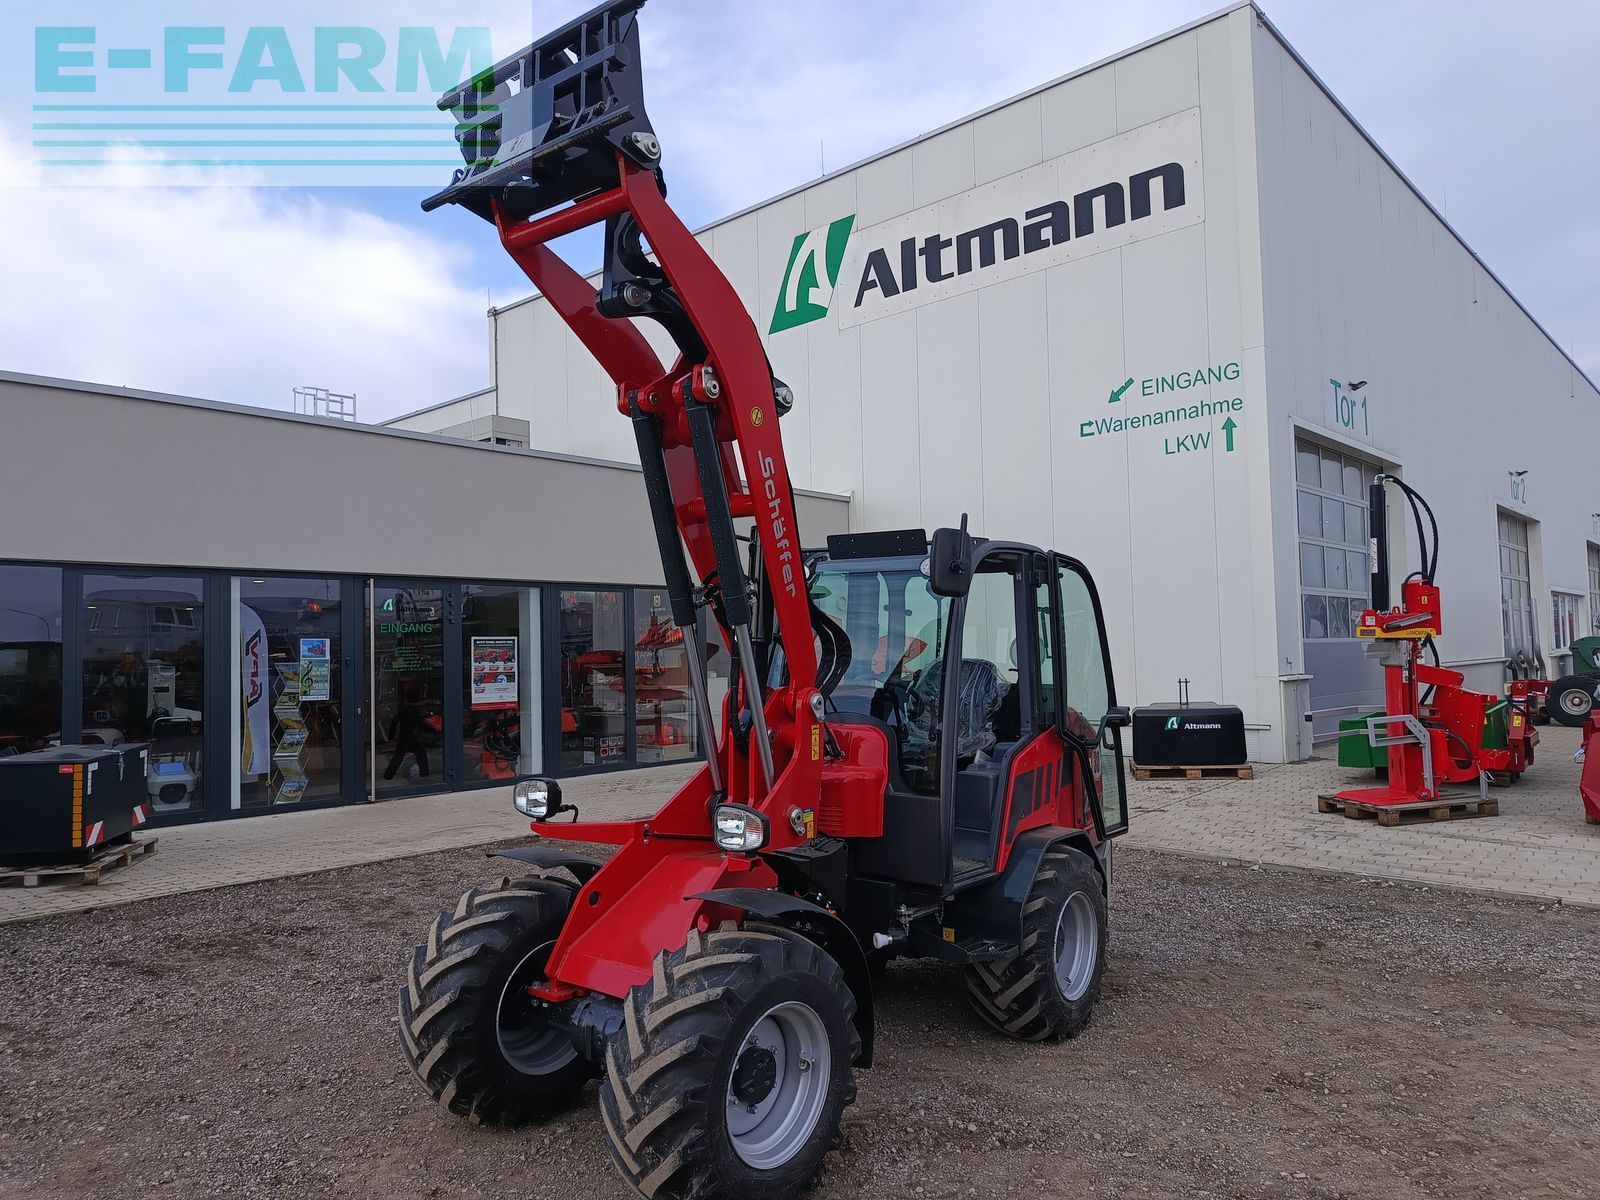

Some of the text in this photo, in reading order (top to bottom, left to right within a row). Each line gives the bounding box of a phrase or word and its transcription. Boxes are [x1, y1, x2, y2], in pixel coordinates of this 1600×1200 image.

[854, 162, 1186, 308] Altmann
[1142, 362, 1240, 396] EINGANG
[1095, 398, 1243, 435] Warenannahme
[1330, 379, 1368, 436] Tor 1
[1165, 432, 1211, 454] LKW
[1508, 471, 1526, 504] Tor 2
[757, 450, 797, 598] Schäffer
[380, 623, 433, 633] EINGANG
